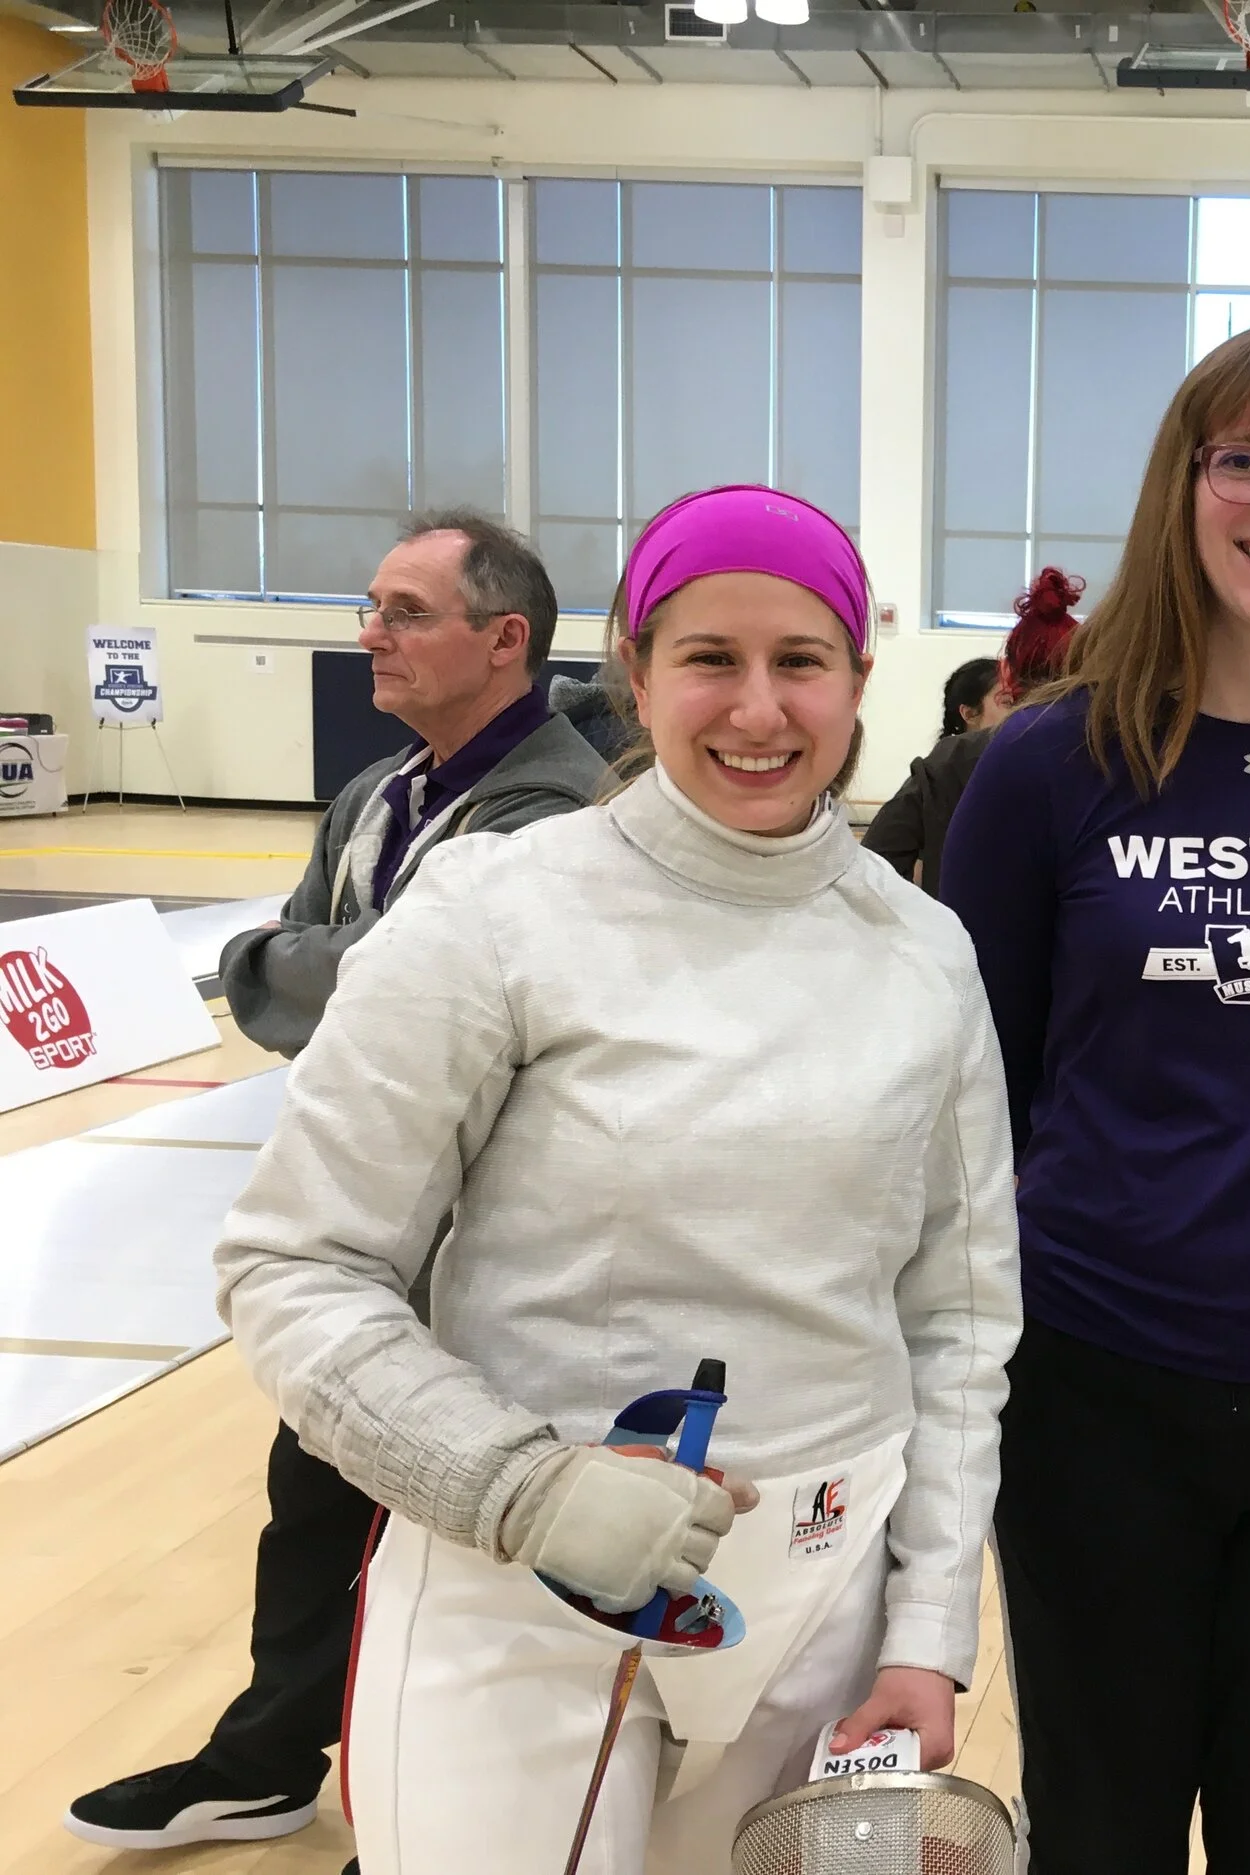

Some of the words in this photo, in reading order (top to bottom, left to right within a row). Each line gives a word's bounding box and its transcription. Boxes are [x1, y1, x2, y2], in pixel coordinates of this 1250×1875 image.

[93, 639, 151, 650] WELCOME
[107, 652, 119, 660] TO
[121, 652, 140, 660] THE
[100, 688, 153, 697] CHAMPIONSHIP
[1162, 958, 1201, 972] EST.
[28, 996, 71, 1043] 2GO
[28, 1032, 98, 1071] SPORT
[795, 1516, 844, 1537] ABSOLUTE
[805, 1541, 833, 1554] U.S.A.
[823, 1753, 899, 1774] DOSEN
